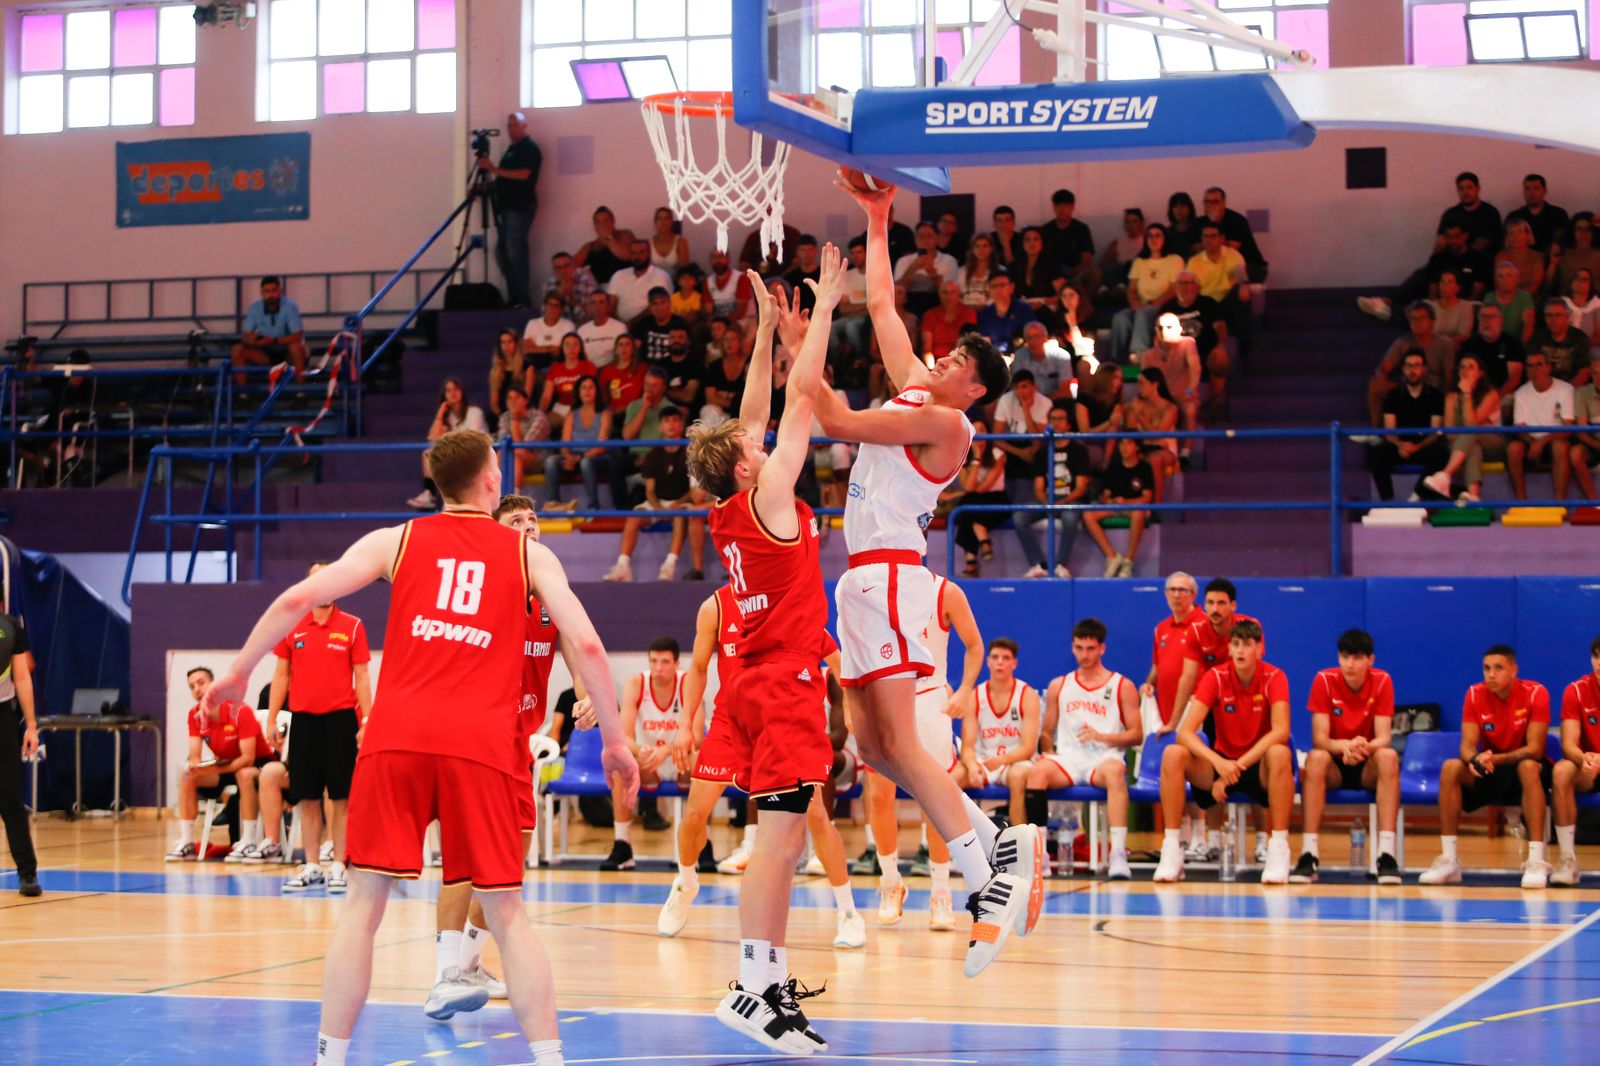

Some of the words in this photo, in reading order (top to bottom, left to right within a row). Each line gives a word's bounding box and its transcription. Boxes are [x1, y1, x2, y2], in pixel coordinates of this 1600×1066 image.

[926, 101, 1028, 125] SPORT
[1030, 96, 1158, 129] SYSTEM
[131, 168, 265, 200] deportes
[723, 541, 747, 594] 11
[436, 558, 485, 615] 18
[411, 615, 493, 649] tipwin
[1066, 699, 1107, 717] ESPAÑA
[981, 724, 1021, 739] ESPAÑA
[698, 764, 719, 775] ING
